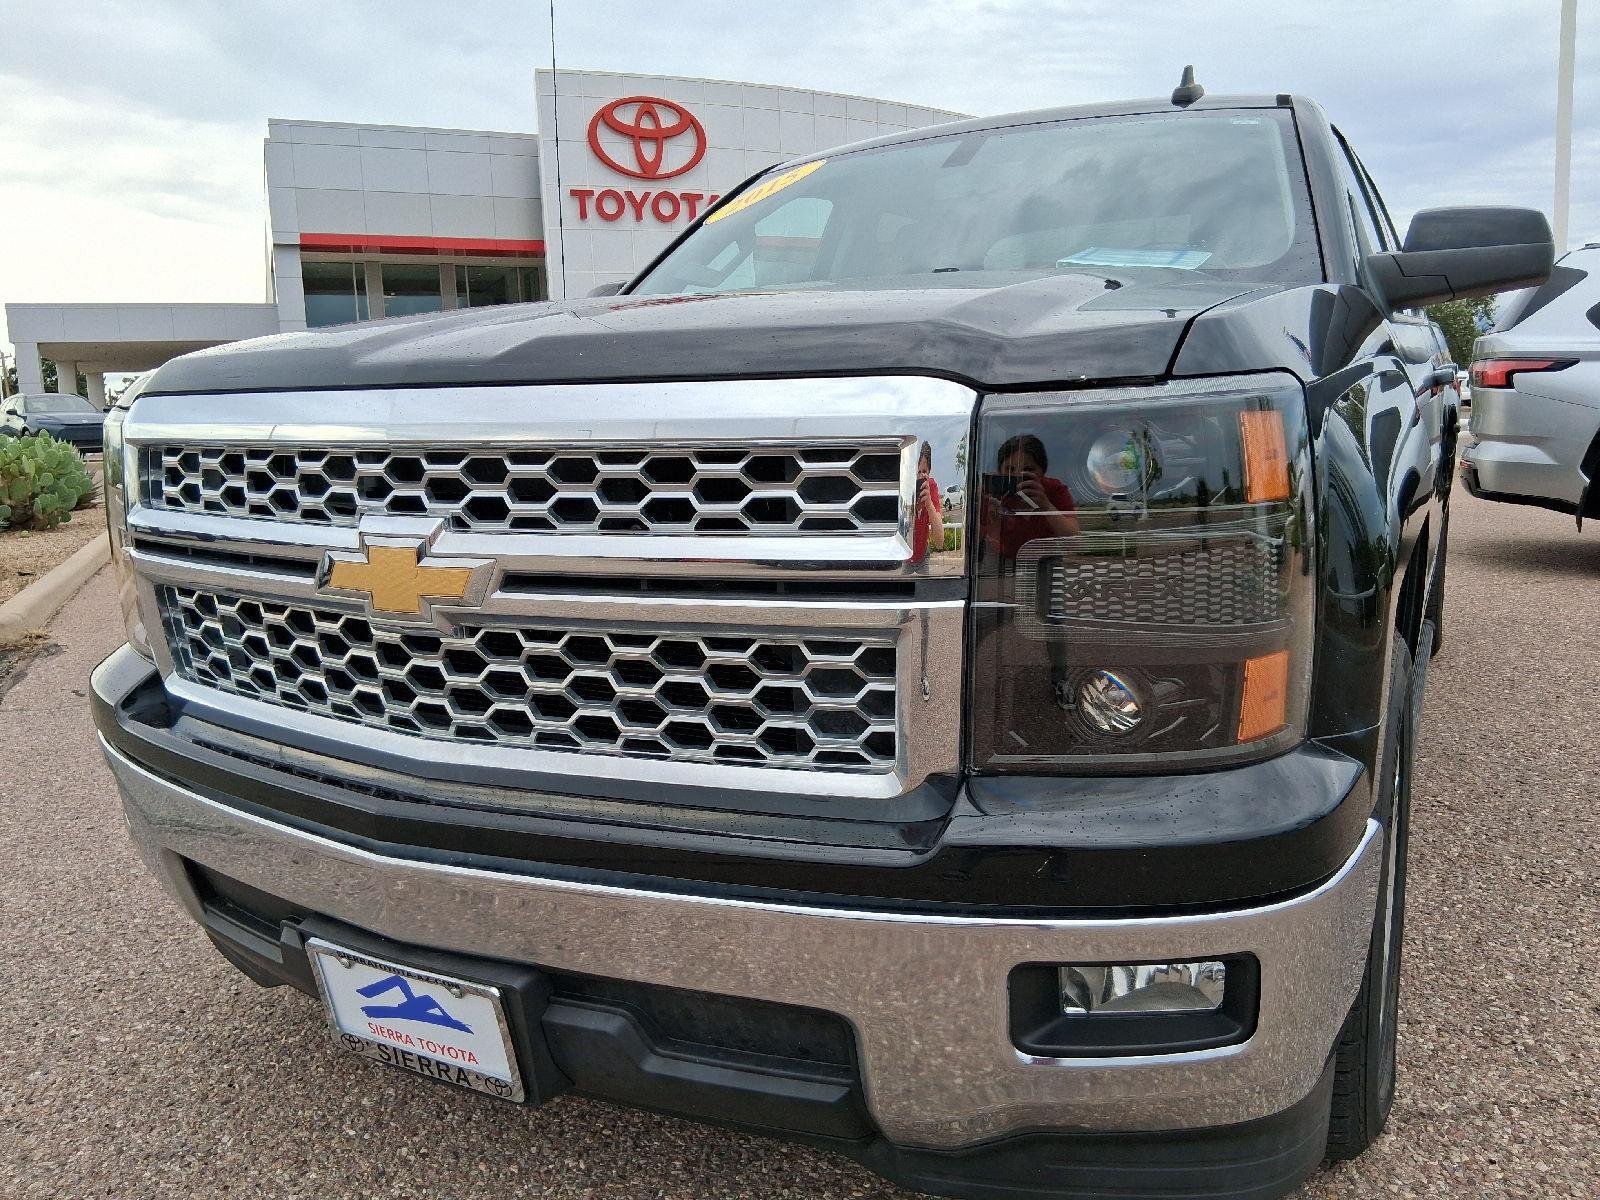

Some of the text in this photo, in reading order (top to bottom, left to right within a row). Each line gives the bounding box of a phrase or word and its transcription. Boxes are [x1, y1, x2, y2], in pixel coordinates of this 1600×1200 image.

[367, 1022, 479, 1065] SIERRA TOYOTA
[376, 1043, 472, 1087] SIERRA
